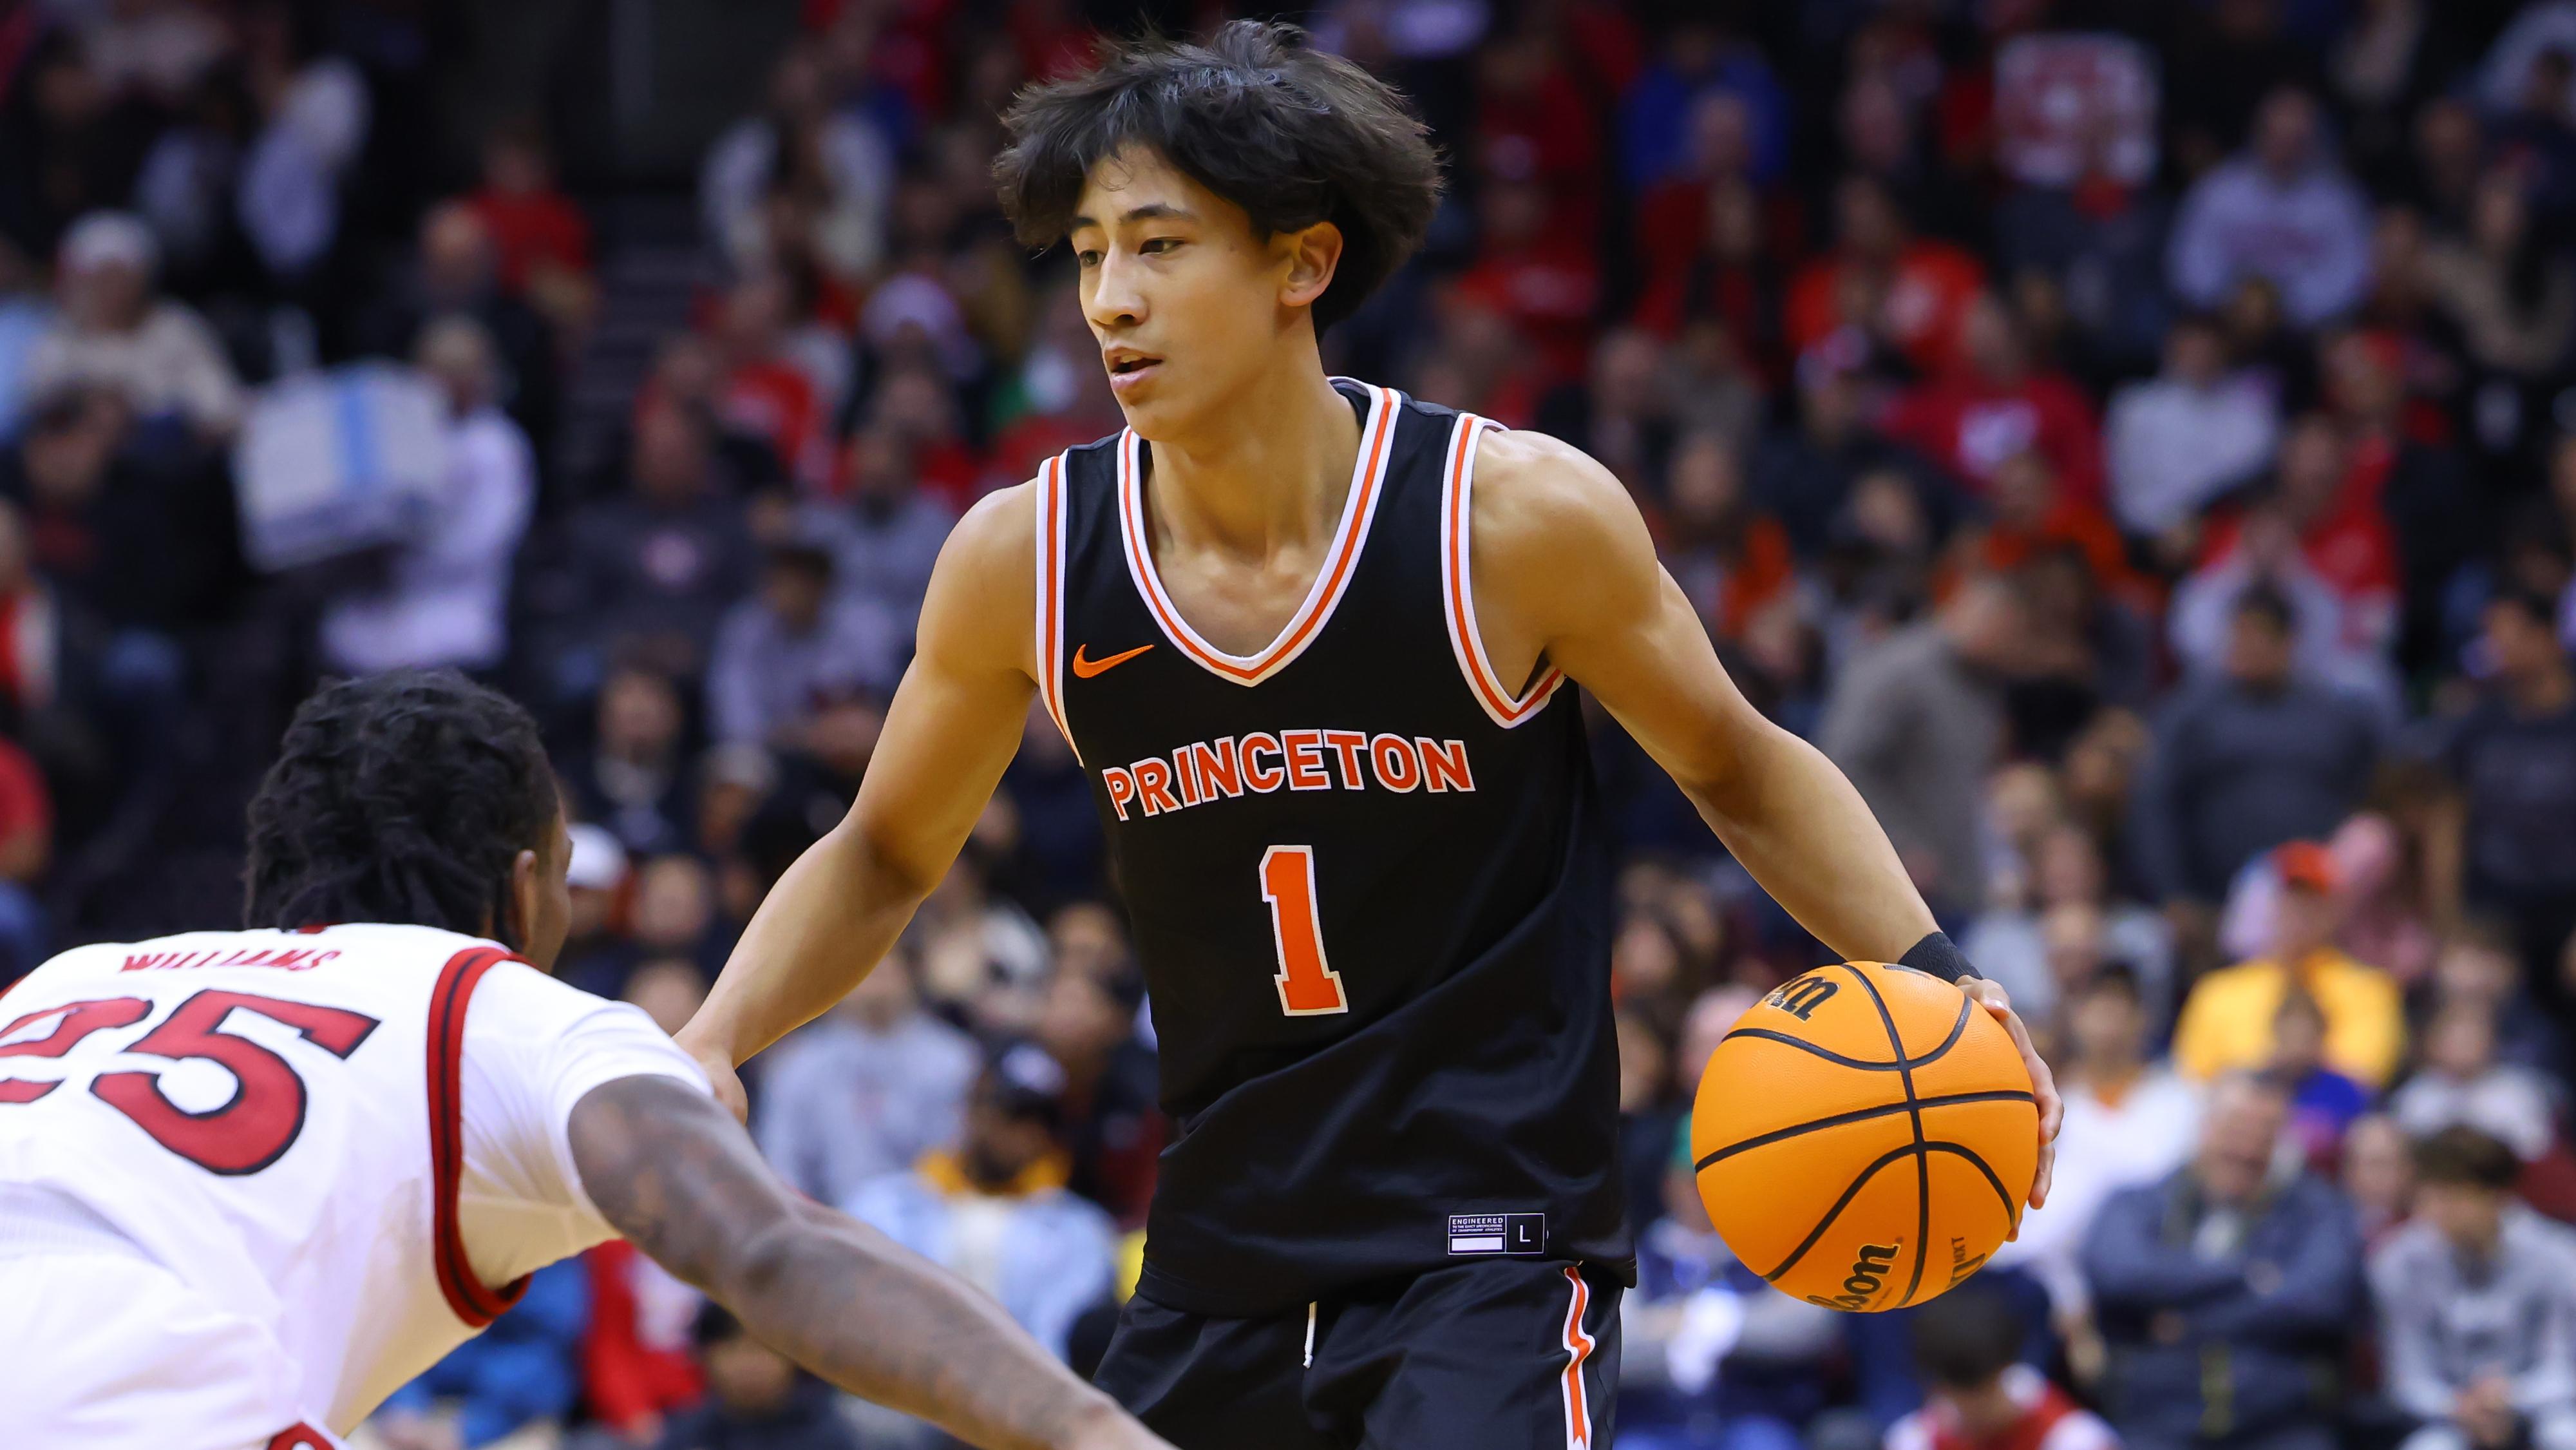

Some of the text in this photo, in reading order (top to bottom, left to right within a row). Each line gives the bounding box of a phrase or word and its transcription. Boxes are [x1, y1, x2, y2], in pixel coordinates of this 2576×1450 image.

[1102, 729, 1475, 821] PRINCETON
[1258, 844, 1348, 1016] 1
[0, 988, 381, 1176] 25
[1520, 1225, 1531, 1242] L
[1806, 1244, 1900, 1312] lson
